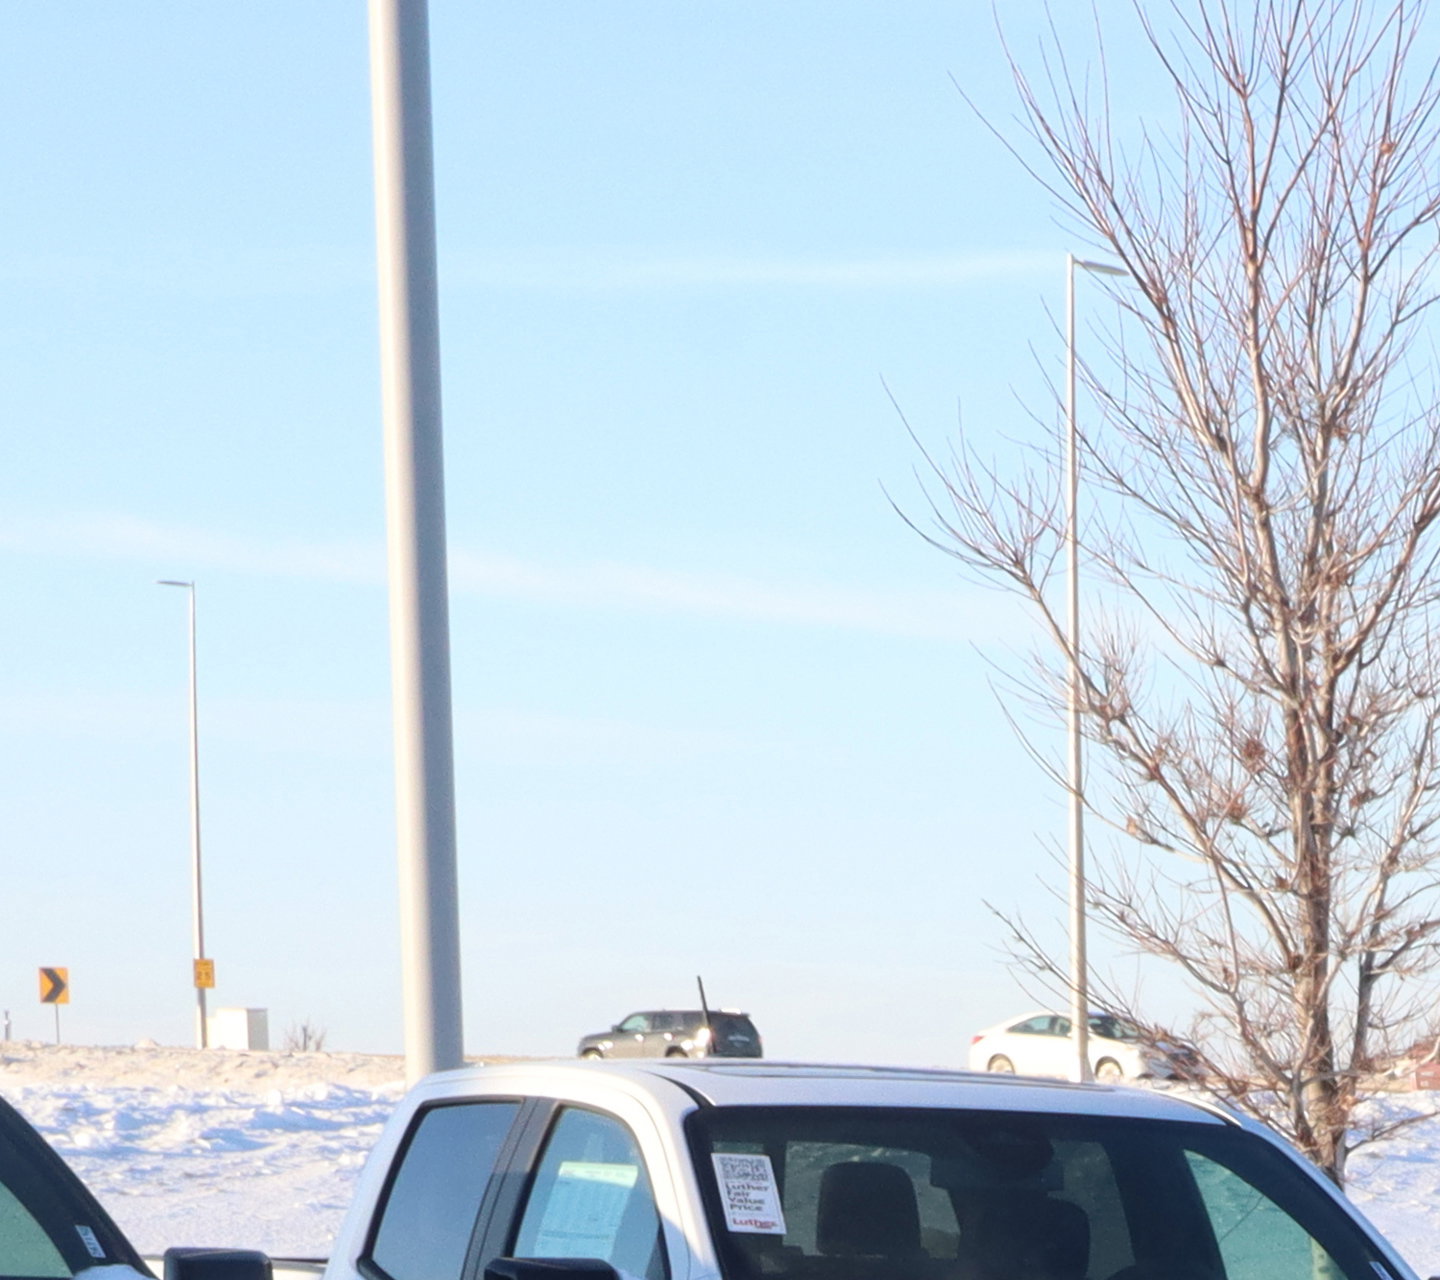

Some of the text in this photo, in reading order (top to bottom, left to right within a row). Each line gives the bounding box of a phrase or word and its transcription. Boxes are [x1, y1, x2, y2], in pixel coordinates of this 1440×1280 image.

[725, 1182, 769, 1192] Luther
[727, 1189, 750, 1197] Fair
[728, 1197, 766, 1205] Value
[730, 1204, 763, 1212] Price
